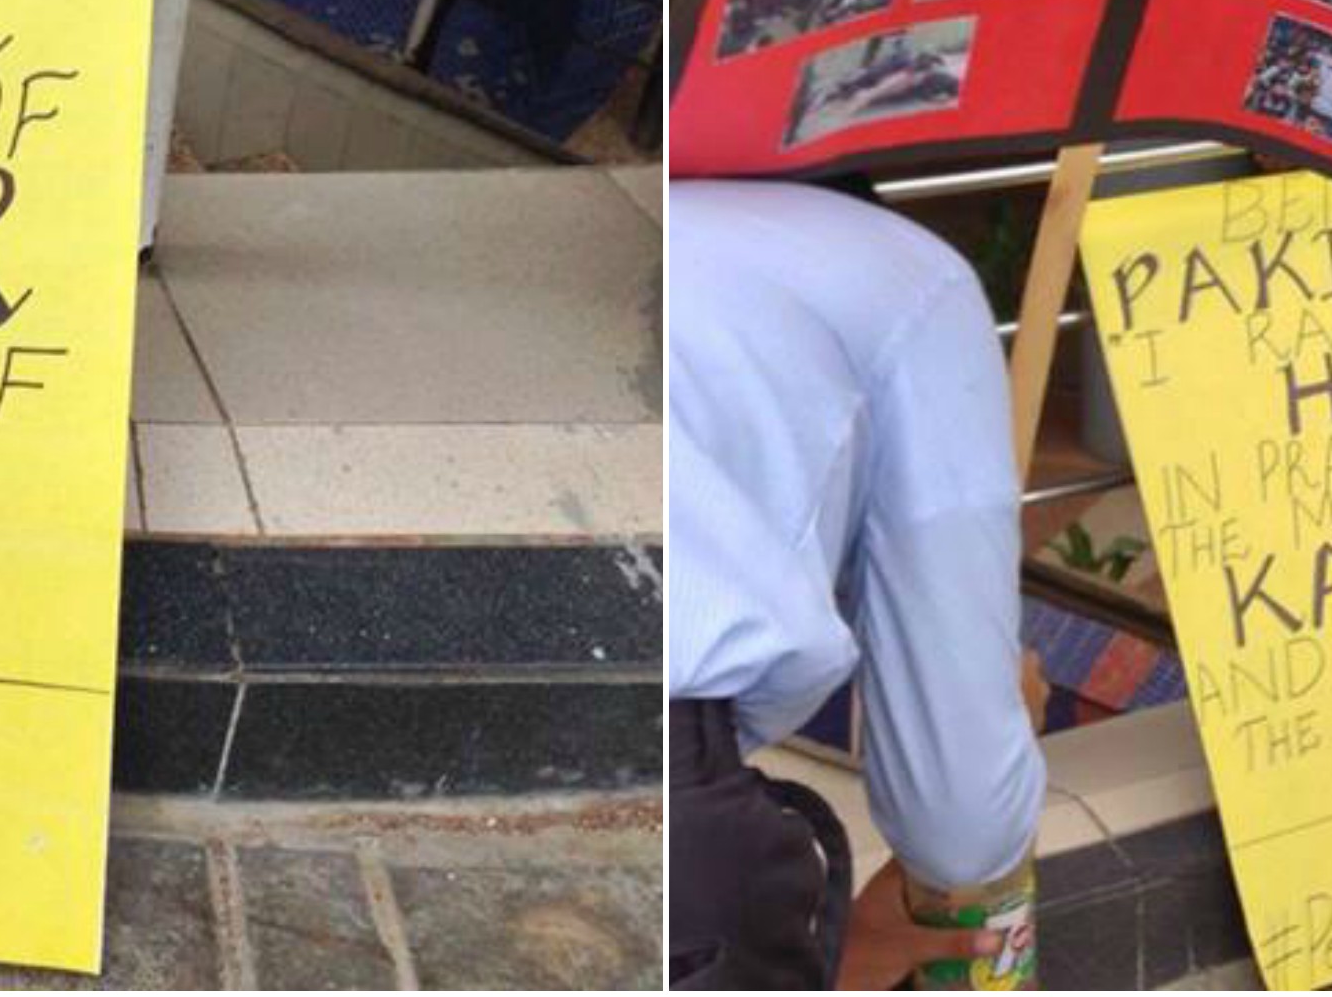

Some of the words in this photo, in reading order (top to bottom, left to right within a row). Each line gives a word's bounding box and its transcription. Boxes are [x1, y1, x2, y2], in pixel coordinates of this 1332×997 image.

[1162, 450, 1222, 525] IN
[1160, 516, 1251, 579] THE
[1195, 638, 1327, 719] AND
[1234, 709, 1323, 773] THE
